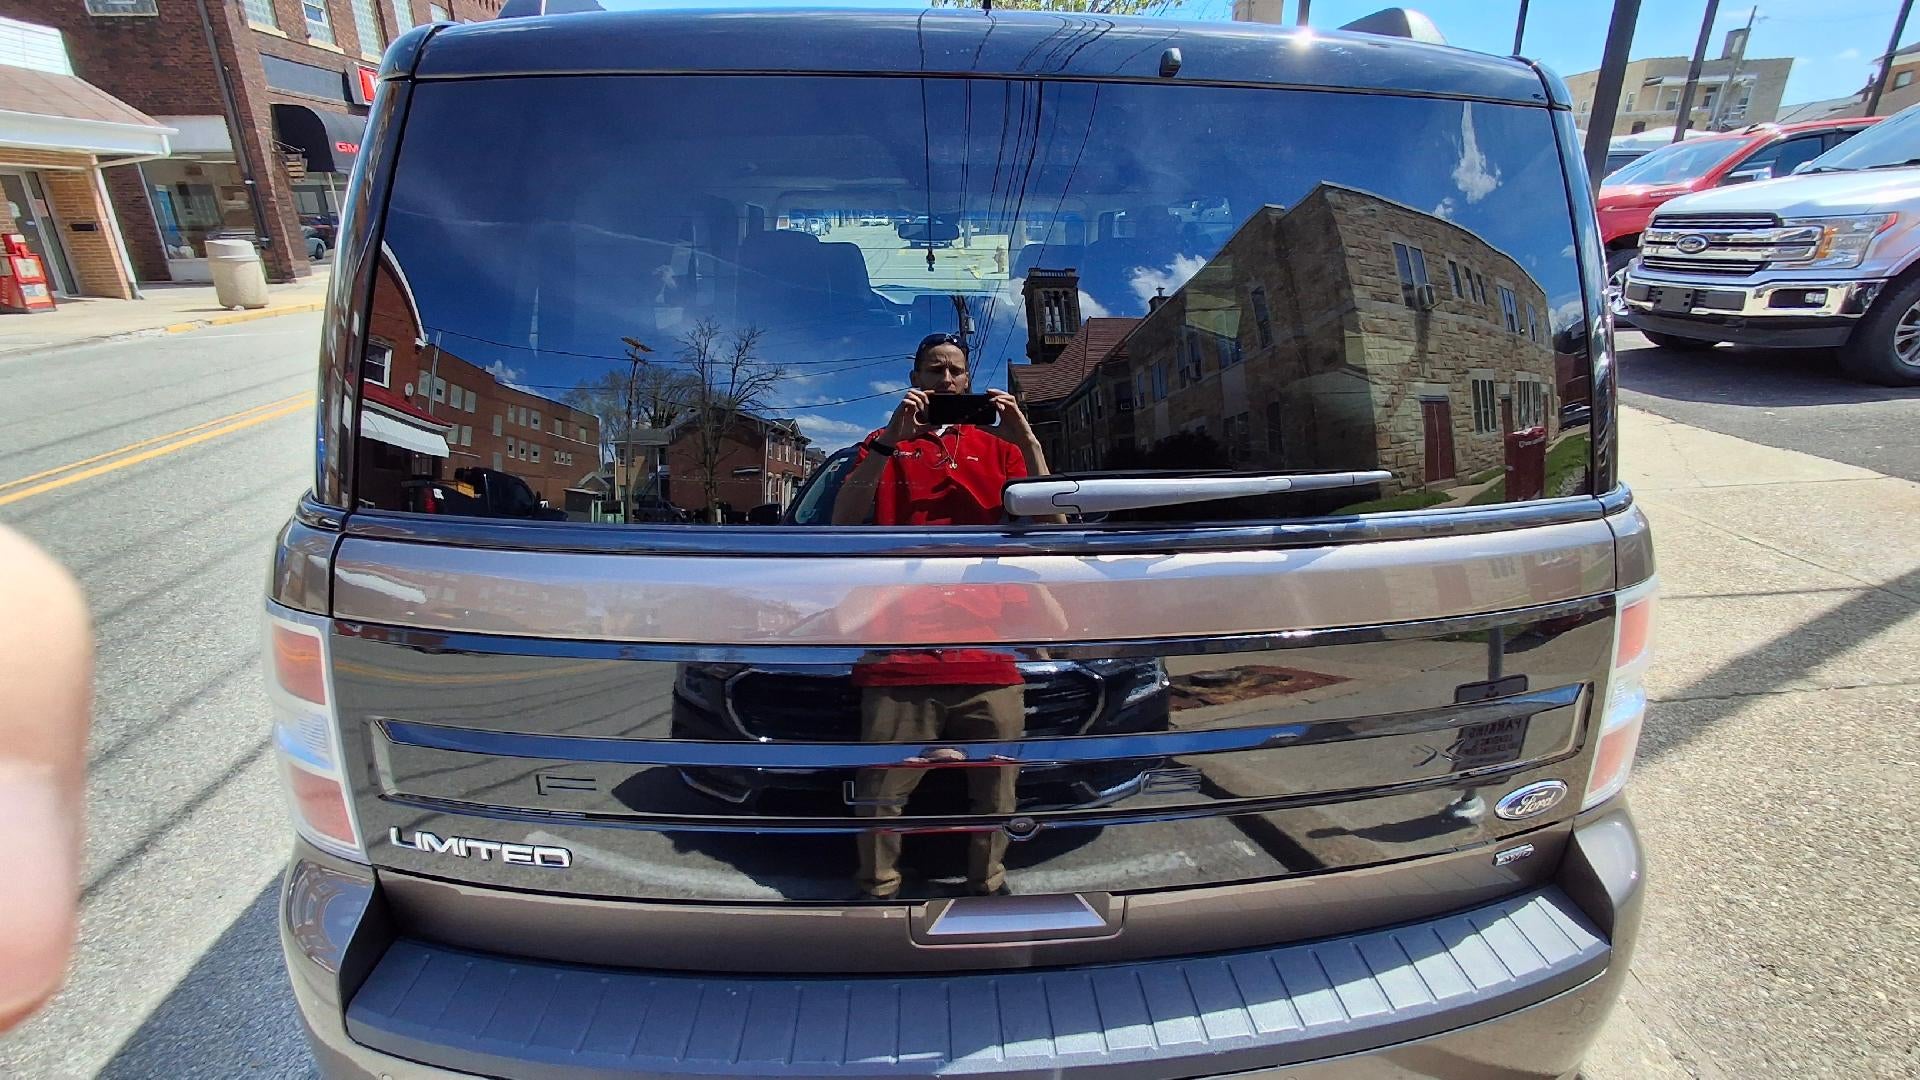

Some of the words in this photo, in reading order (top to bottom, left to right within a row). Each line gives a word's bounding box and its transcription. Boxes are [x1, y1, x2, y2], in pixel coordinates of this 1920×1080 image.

[335, 142, 359, 154] GM
[1514, 790, 1556, 815] Ford
[389, 825, 573, 868] LIMITED
